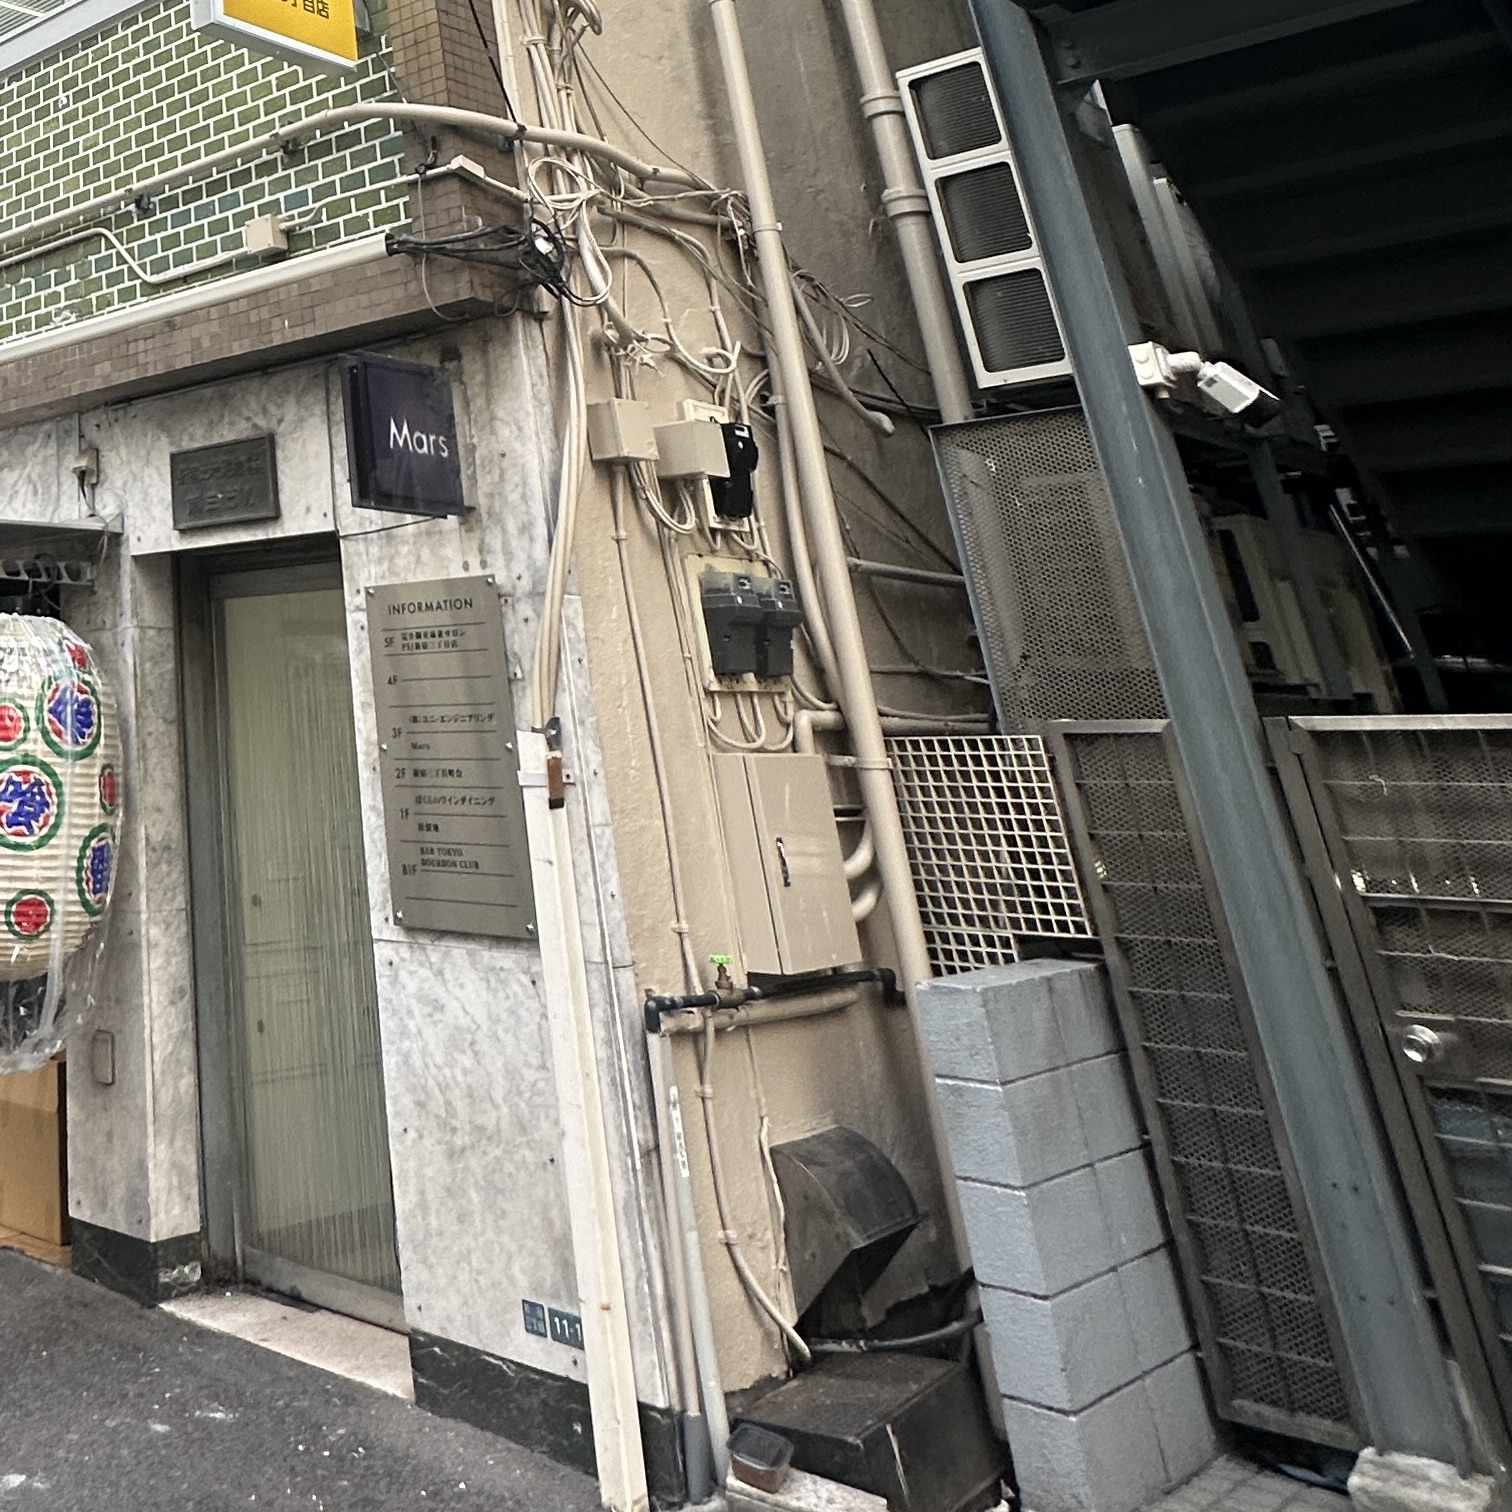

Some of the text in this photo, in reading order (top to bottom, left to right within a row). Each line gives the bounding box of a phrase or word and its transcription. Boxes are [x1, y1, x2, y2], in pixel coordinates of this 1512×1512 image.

[389, 415, 449, 458] Mars
[388, 597, 474, 616] INFORMATION
[387, 675, 398, 686] 4F
[392, 727, 402, 739] 3F
[395, 768, 407, 779] 2F
[400, 808, 410, 820] 1F
[459, 860, 480, 870] CLUB
